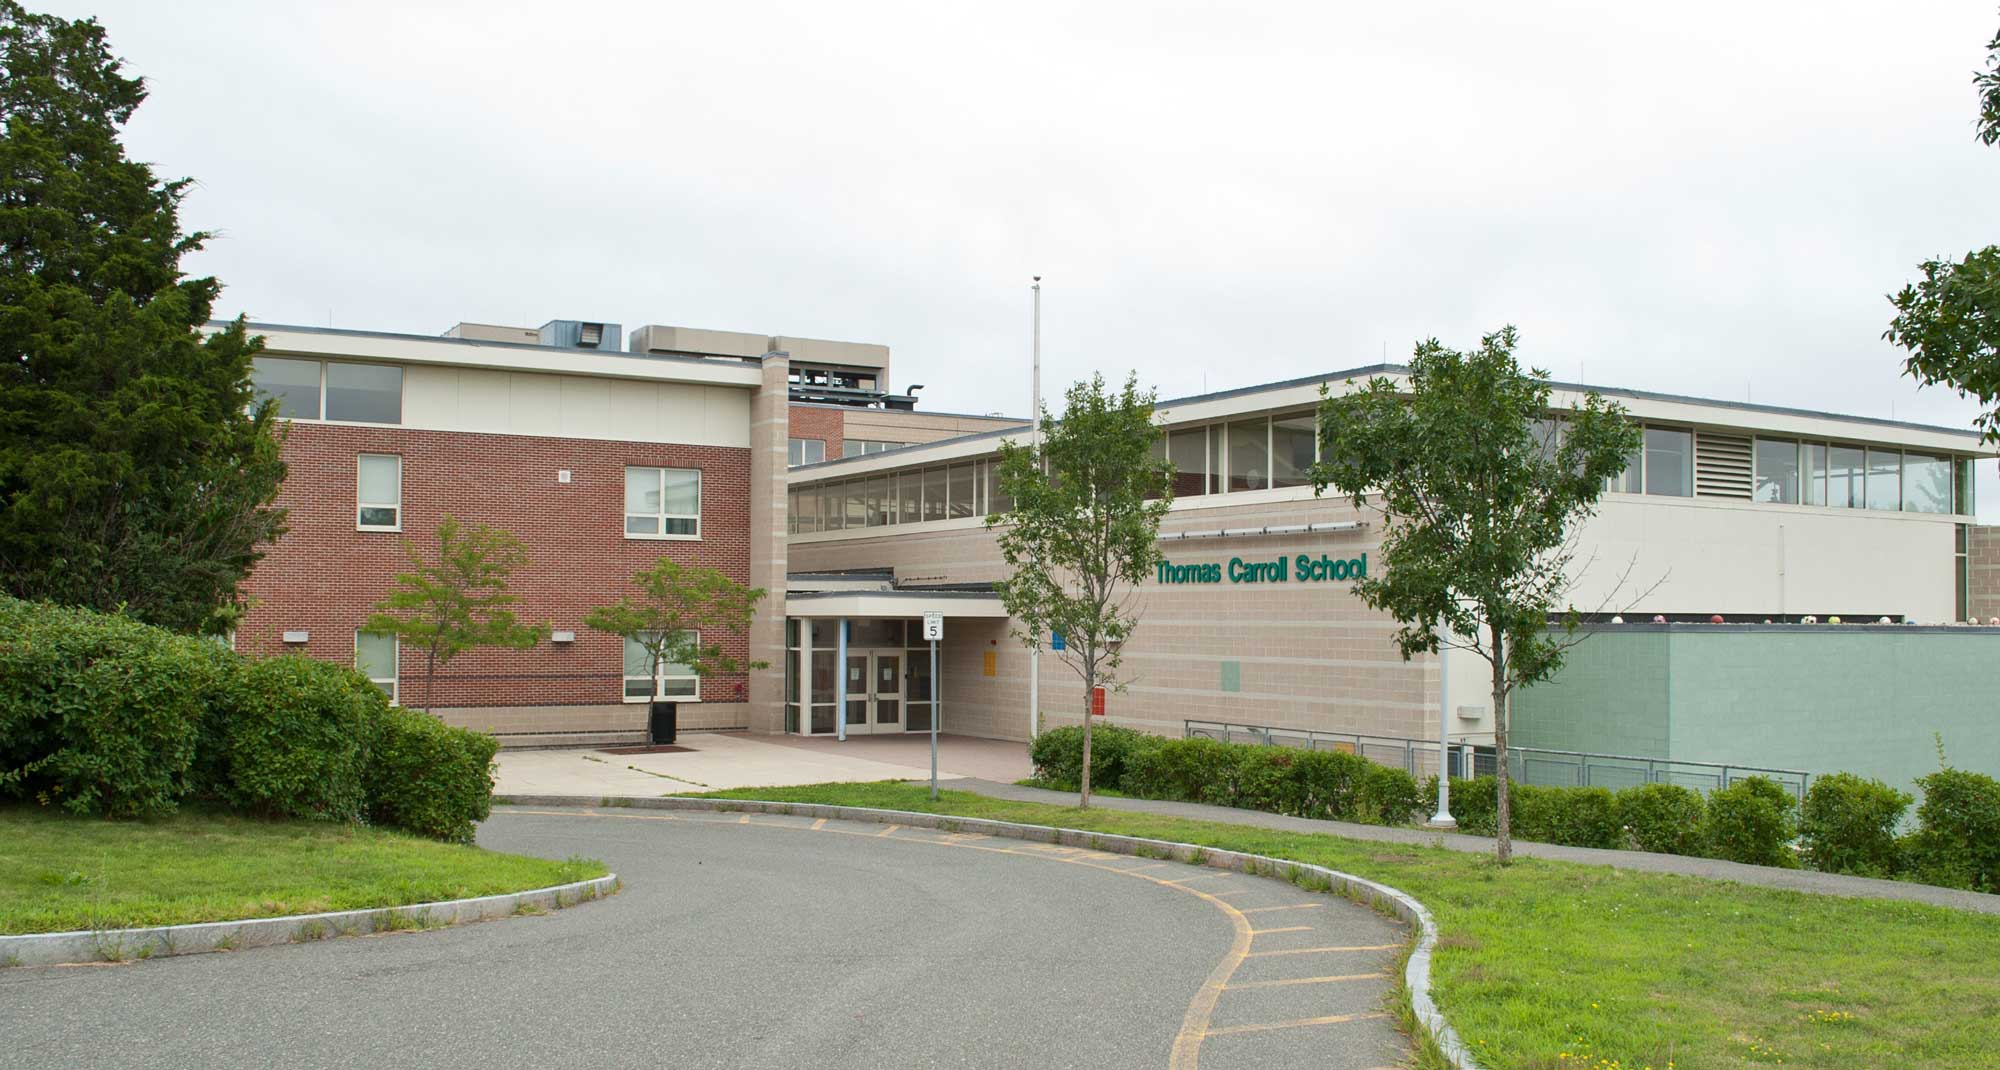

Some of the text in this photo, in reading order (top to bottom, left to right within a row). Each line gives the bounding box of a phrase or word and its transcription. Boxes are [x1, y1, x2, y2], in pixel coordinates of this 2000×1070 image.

[1156, 553, 1367, 584] Thomas Carroll School
[930, 625, 937, 637] 5
